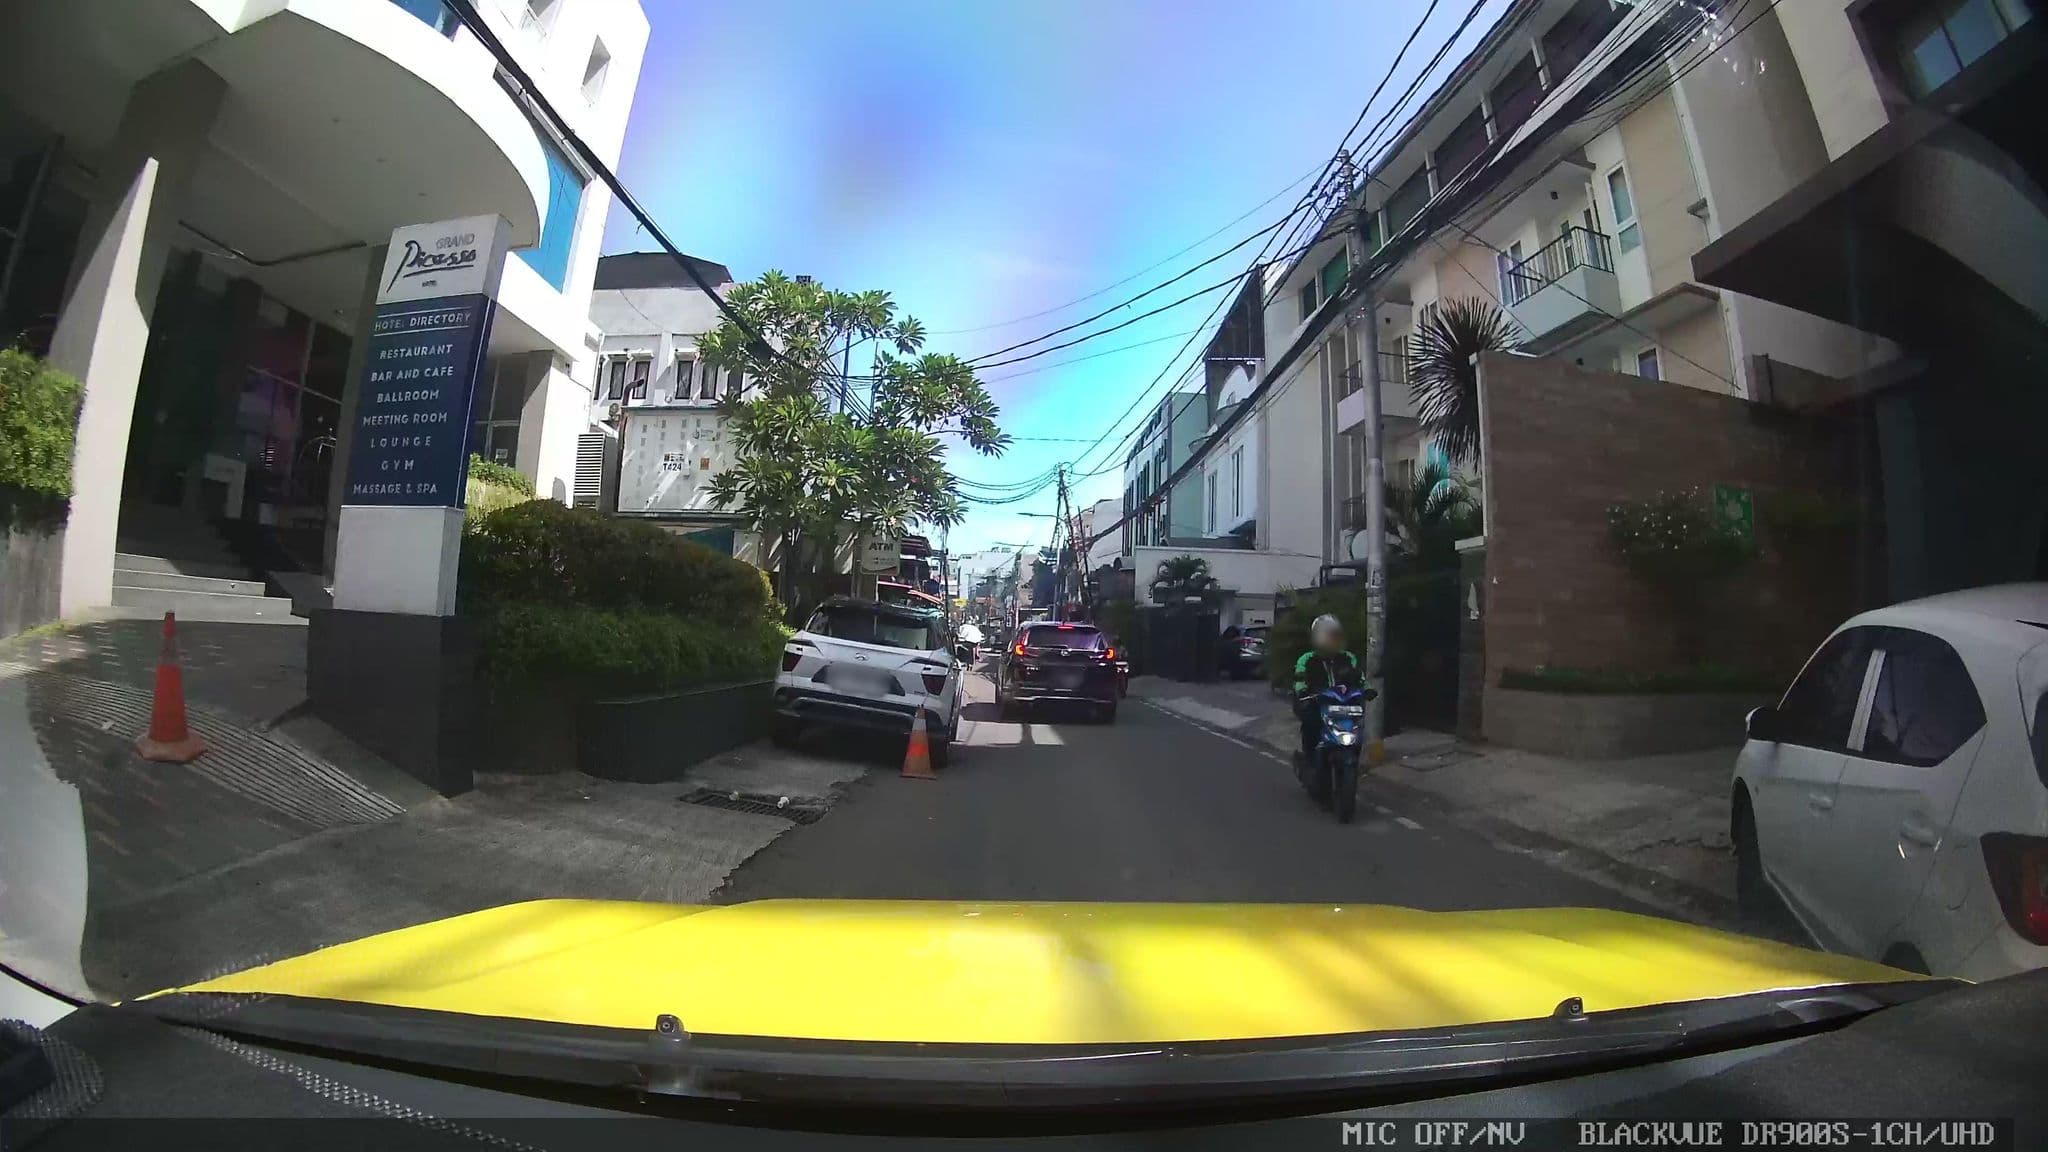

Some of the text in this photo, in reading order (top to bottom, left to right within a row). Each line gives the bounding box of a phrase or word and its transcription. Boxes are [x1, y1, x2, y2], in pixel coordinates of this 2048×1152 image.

[436, 232, 475, 249] GRAND
[386, 240, 476, 293] Picasso
[410, 312, 471, 327] DIRECTORY
[380, 344, 453, 359] RESTAURANT
[371, 366, 454, 381] BAR AND CAFE
[377, 390, 439, 403] BALLROOM
[363, 412, 448, 426] MEETING ROOM
[370, 436, 431, 448] LOUNGE
[381, 459, 414, 471] GYM
[663, 462, 682, 471] T424
[353, 483, 401, 494] MASSAGE
[417, 483, 438, 493] SPA
[869, 542, 894, 551] ATM
